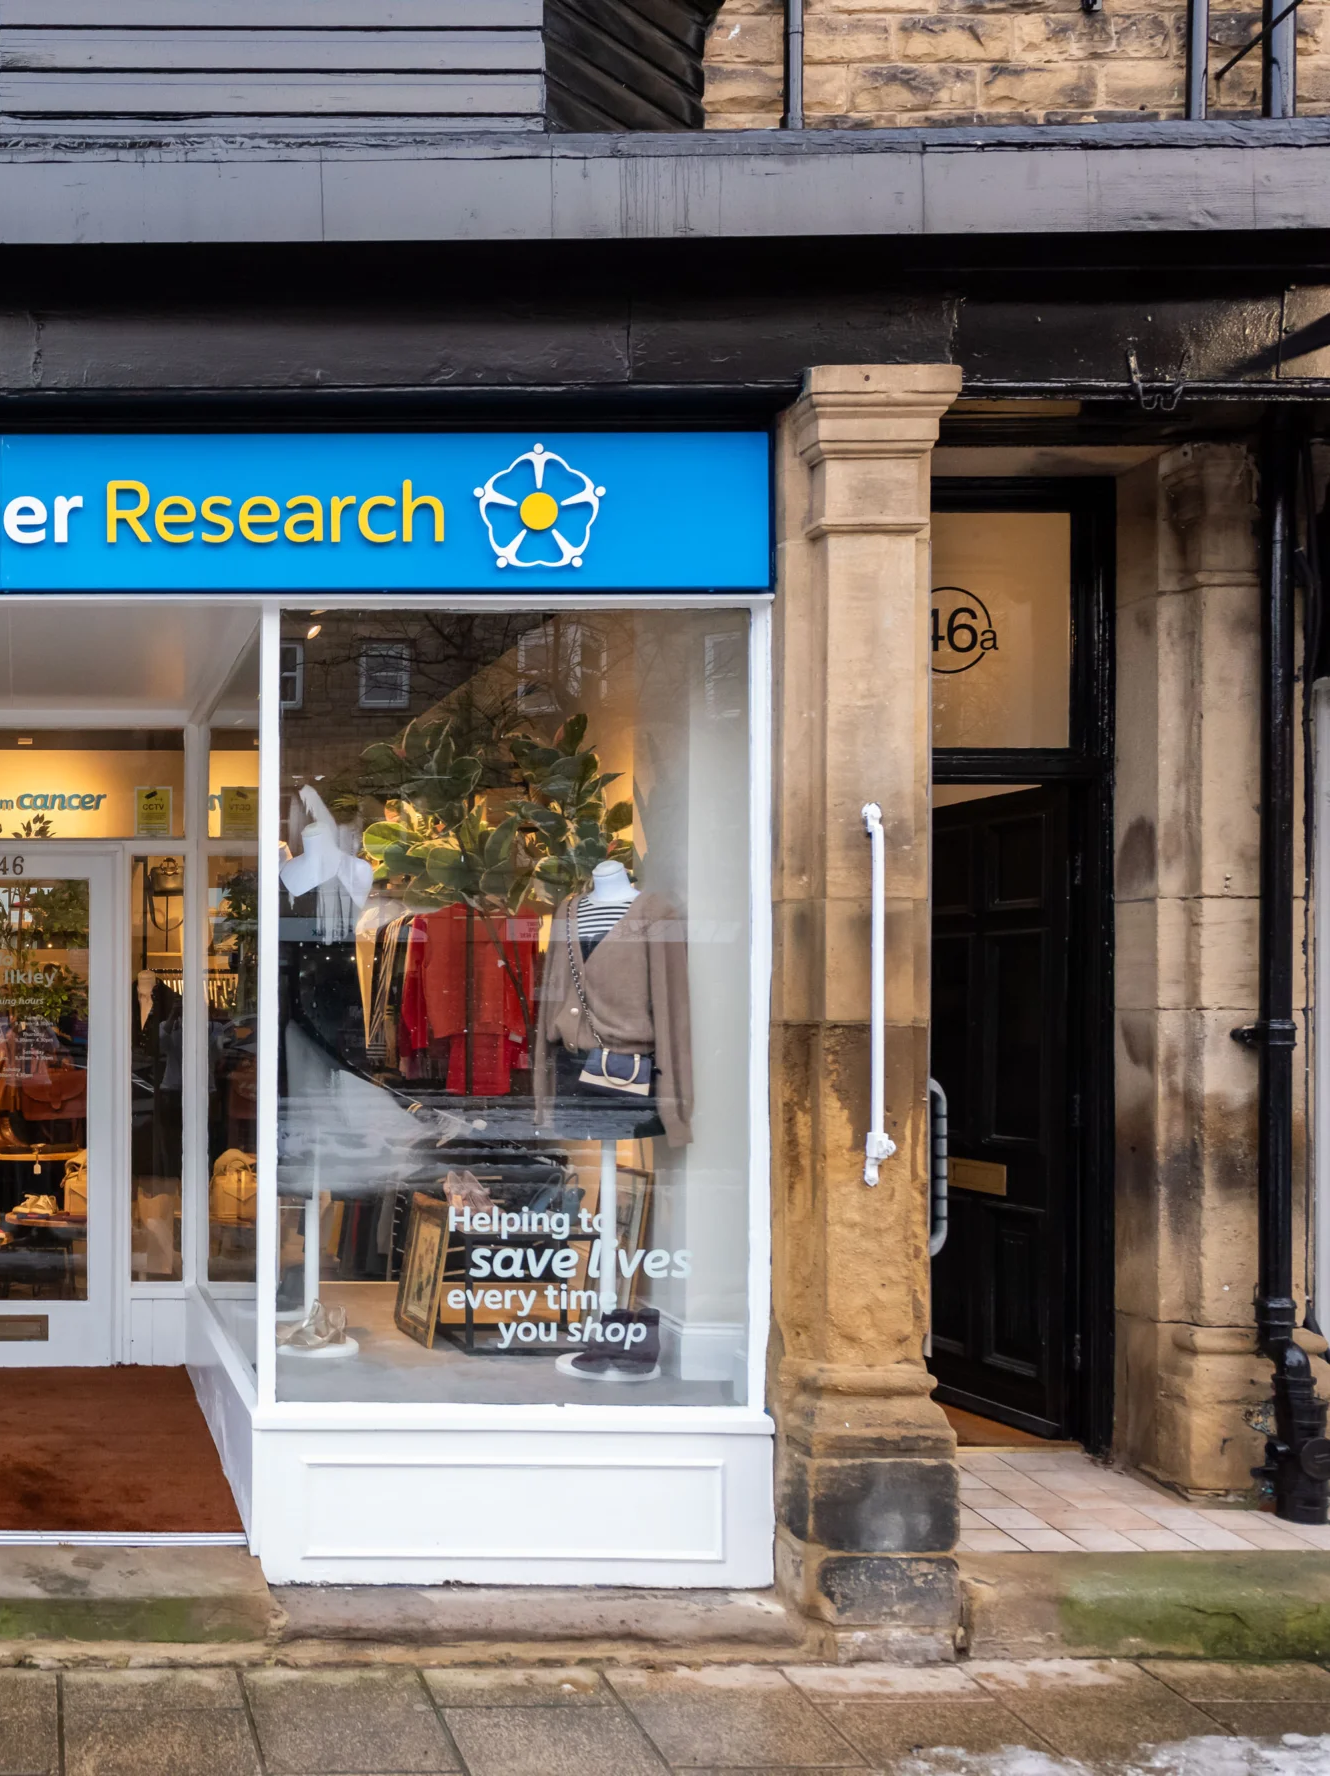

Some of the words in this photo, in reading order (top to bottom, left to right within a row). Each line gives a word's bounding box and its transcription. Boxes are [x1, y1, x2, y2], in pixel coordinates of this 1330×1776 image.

[105, 478, 446, 545] Research
[17, 793, 107, 811] cancer
[142, 803, 165, 811] CCTV
[4, 967, 58, 988] Ilkley
[18, 997, 44, 1005] hours
[448, 1206, 570, 1239] Helping
[577, 1211, 613, 1234] to
[468, 1247, 579, 1279] save
[587, 1238, 694, 1279] lives
[446, 1287, 537, 1317] every
[543, 1284, 618, 1311] time
[497, 1321, 558, 1349] you
[566, 1316, 647, 1350] shop
